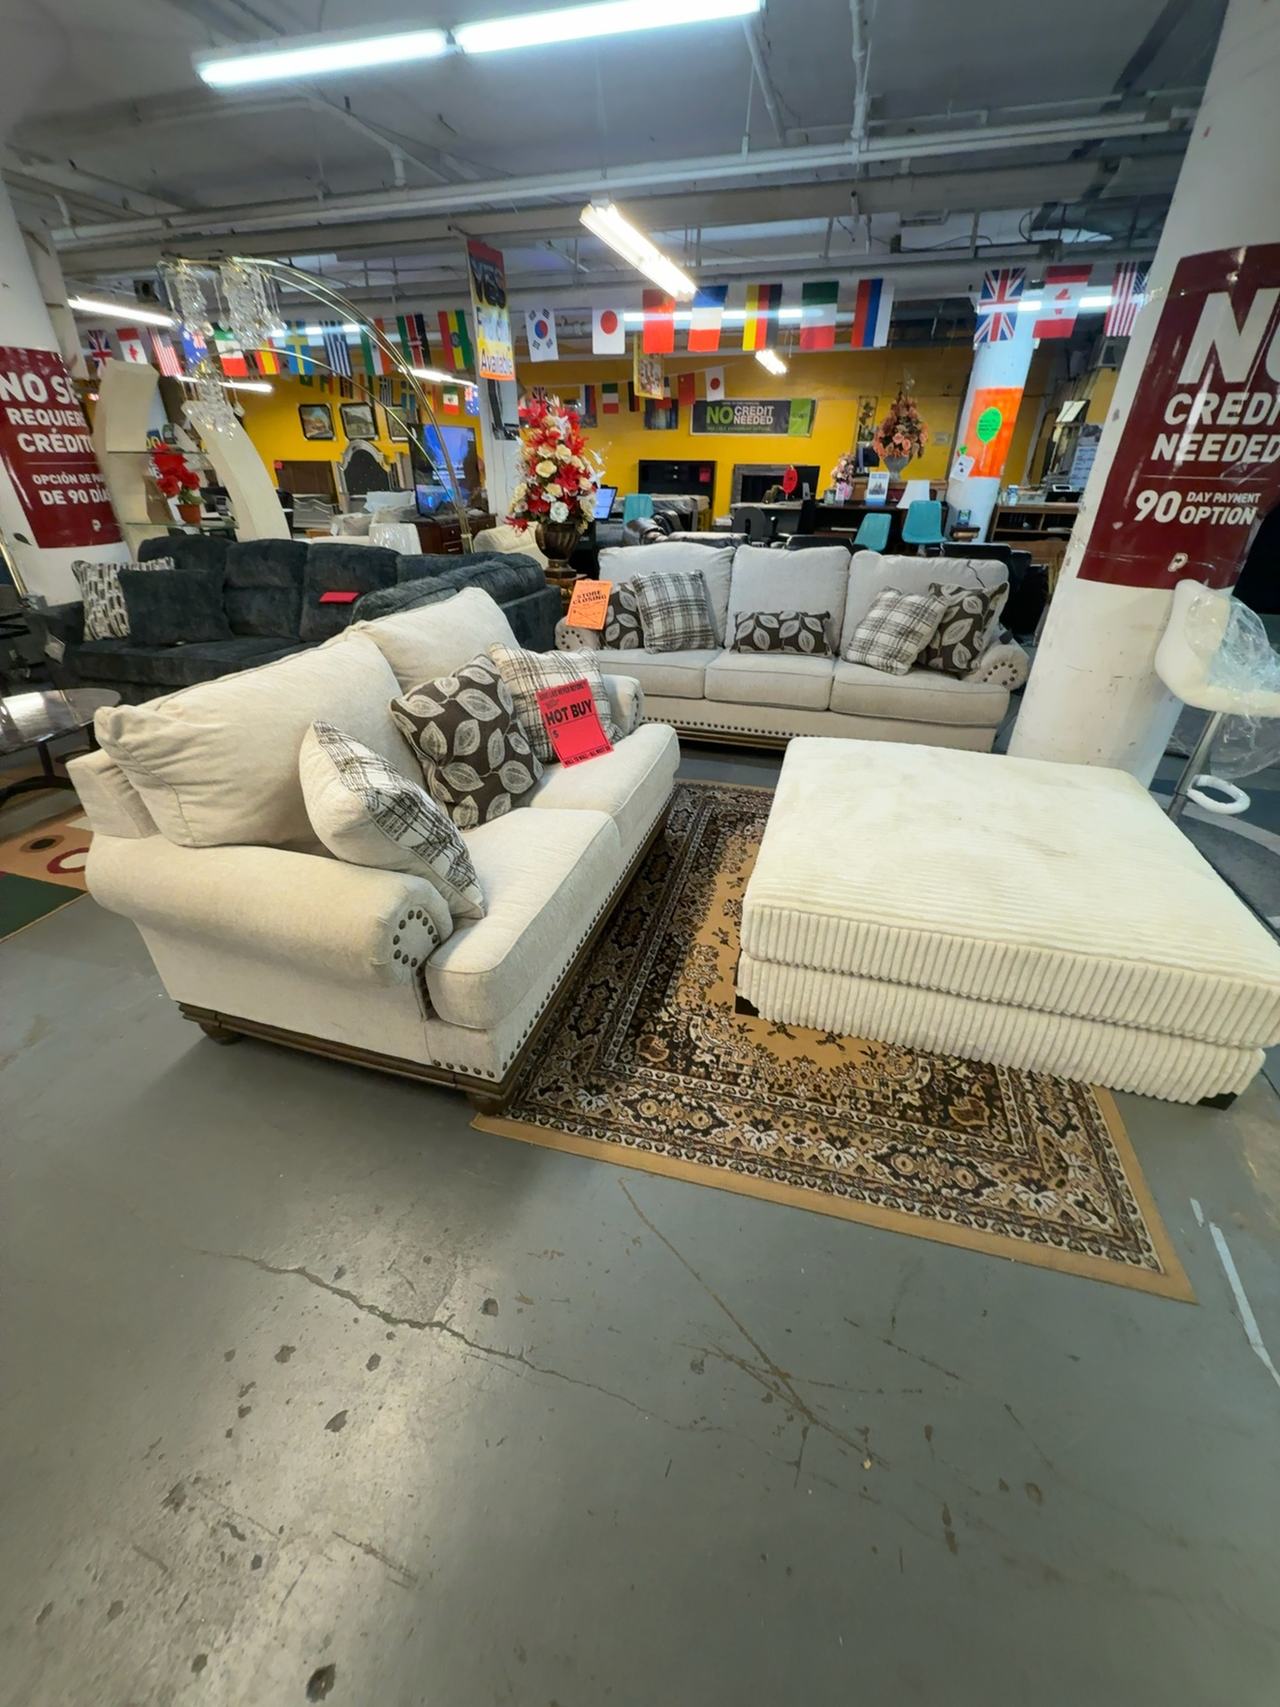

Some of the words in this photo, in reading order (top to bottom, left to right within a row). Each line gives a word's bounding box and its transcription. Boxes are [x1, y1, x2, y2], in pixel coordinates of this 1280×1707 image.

[1177, 288, 1280, 385] N
[0, 371, 49, 404] NO
[707, 406, 733, 424] NO
[735, 406, 774, 416] CREDIT
[734, 416, 774, 424] NEEDED
[1164, 391, 1280, 426] CREDI
[1150, 432, 1280, 462] NEEDED
[32, 471, 78, 485] OPCIÓN
[78, 473, 92, 484] DE
[40, 490, 68, 505] DE
[67, 489, 89, 504] 90
[1134, 489, 1182, 523] 90
[1186, 491, 1214, 503] DAY
[1213, 492, 1262, 504] PAYMENT
[1180, 506, 1258, 525] OPTION
[545, 706, 569, 726] HOT
[570, 699, 593, 718] BUY
